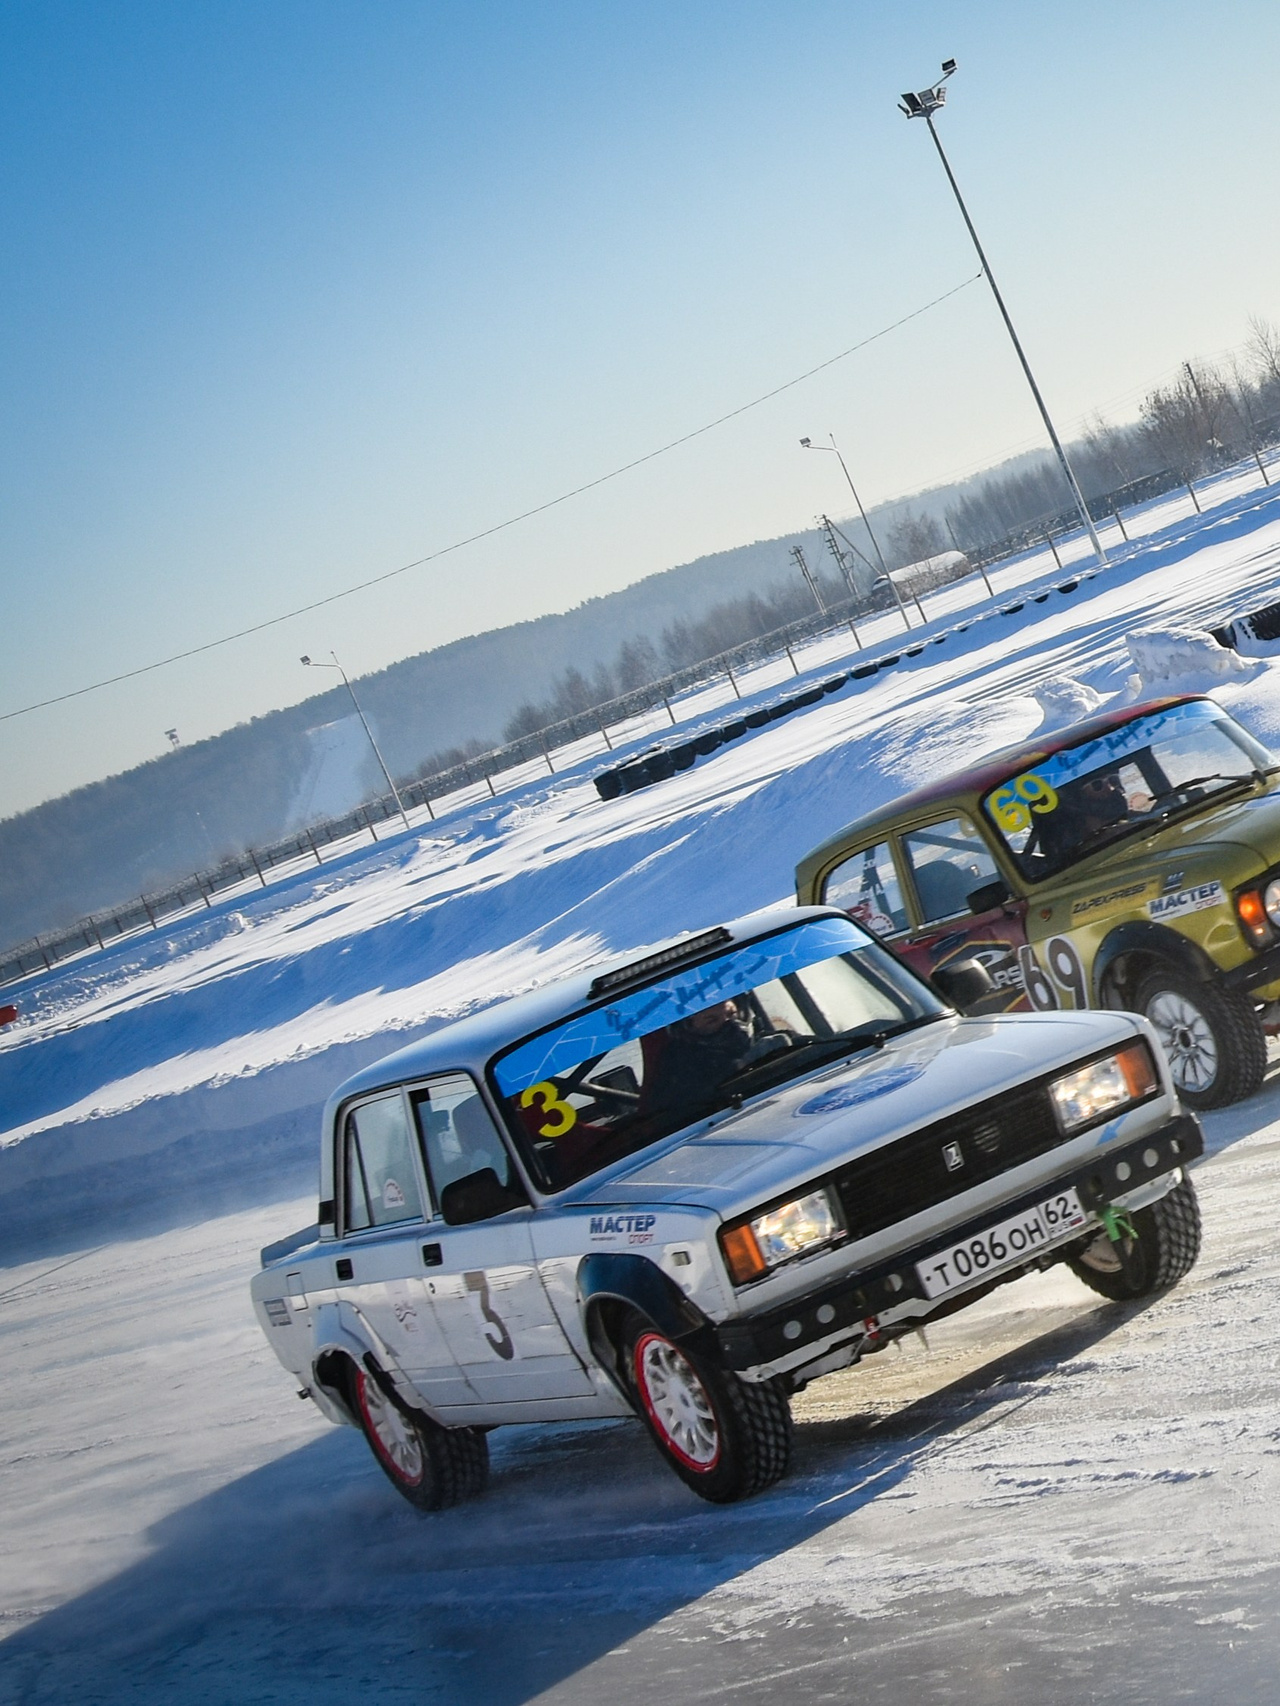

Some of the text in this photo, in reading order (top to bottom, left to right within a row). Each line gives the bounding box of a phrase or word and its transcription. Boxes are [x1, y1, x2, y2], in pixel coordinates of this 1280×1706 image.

[989, 774, 1059, 832] 69
[1149, 883, 1221, 914] МАСТЕР
[1018, 935, 1090, 1011] 69
[520, 1081, 577, 1138] 3
[590, 1214, 656, 1234] МАСТЕР
[463, 1270, 515, 1361] 3
